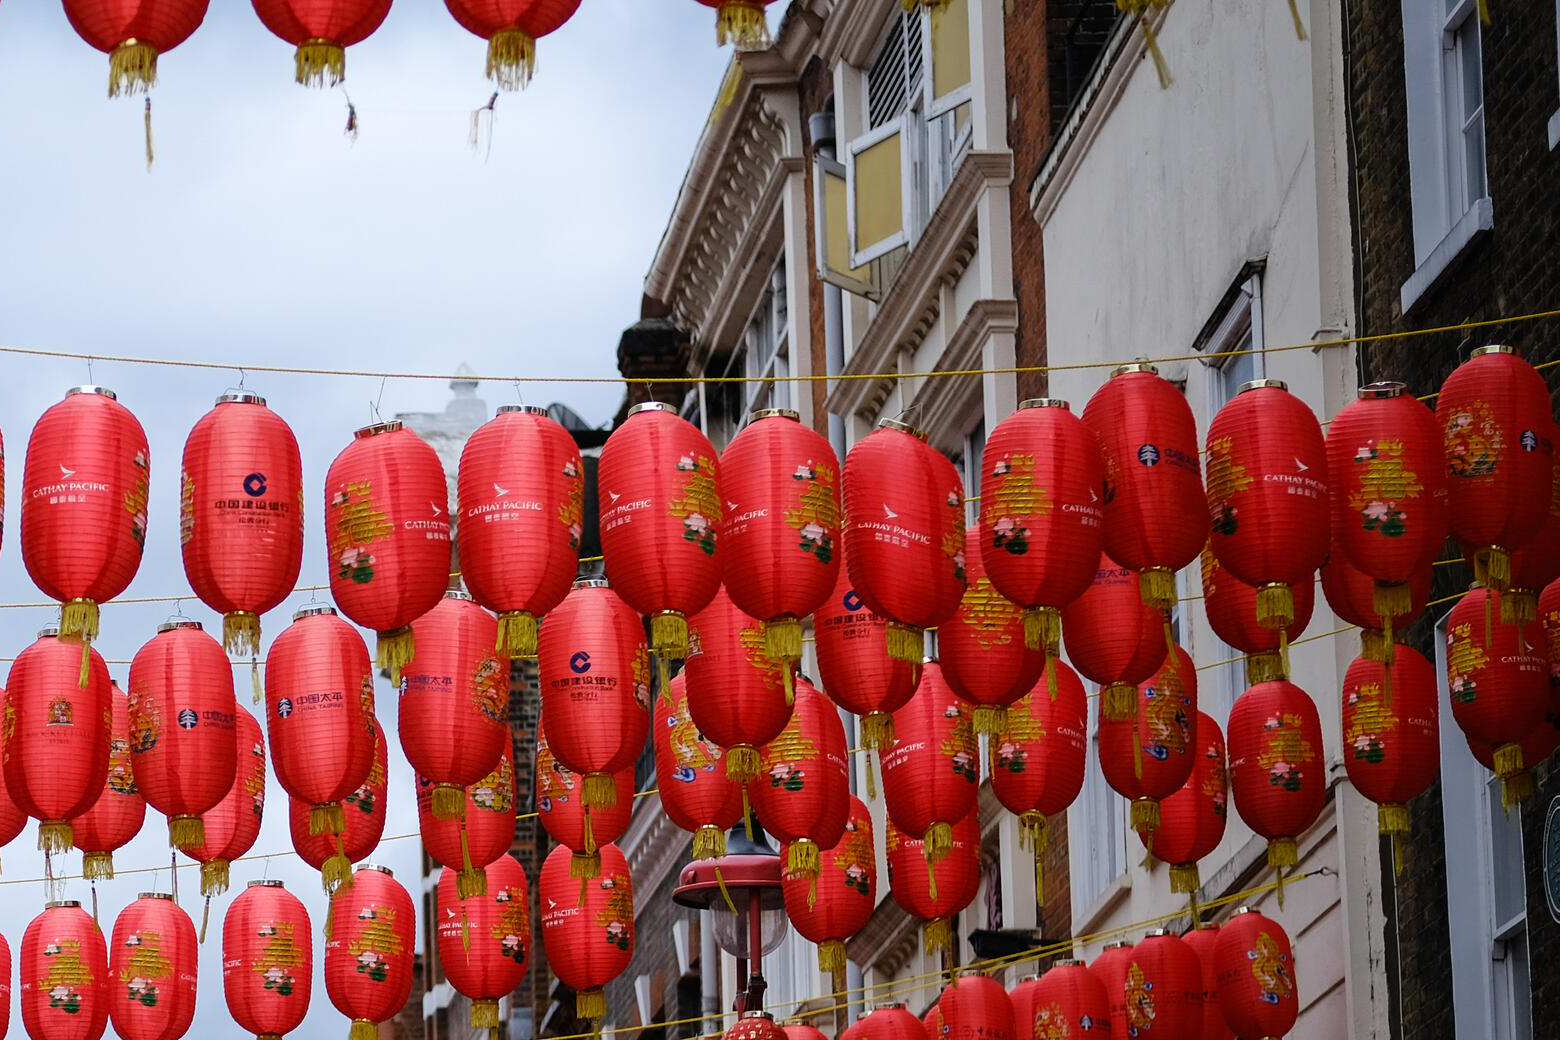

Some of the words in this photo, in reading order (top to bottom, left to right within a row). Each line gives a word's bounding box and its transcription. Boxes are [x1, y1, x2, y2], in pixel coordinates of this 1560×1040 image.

[1264, 474, 1304, 484] CATHAY
[33, 484, 69, 498] CATHAY
[70, 482, 109, 492] PACIFIC
[468, 502, 500, 517] CATHAY
[503, 500, 542, 511] PACIFIC
[617, 499, 652, 514] PACIFIC
[734, 508, 769, 523] PACIFIC
[404, 519, 441, 530] CATHAY
[858, 522, 891, 532] CATHAY
[893, 525, 931, 545] PACIFIC
[296, 692, 342, 705] 中国太平
[897, 742, 925, 754] PACIFIC
[554, 909, 579, 917] PACIFIC
